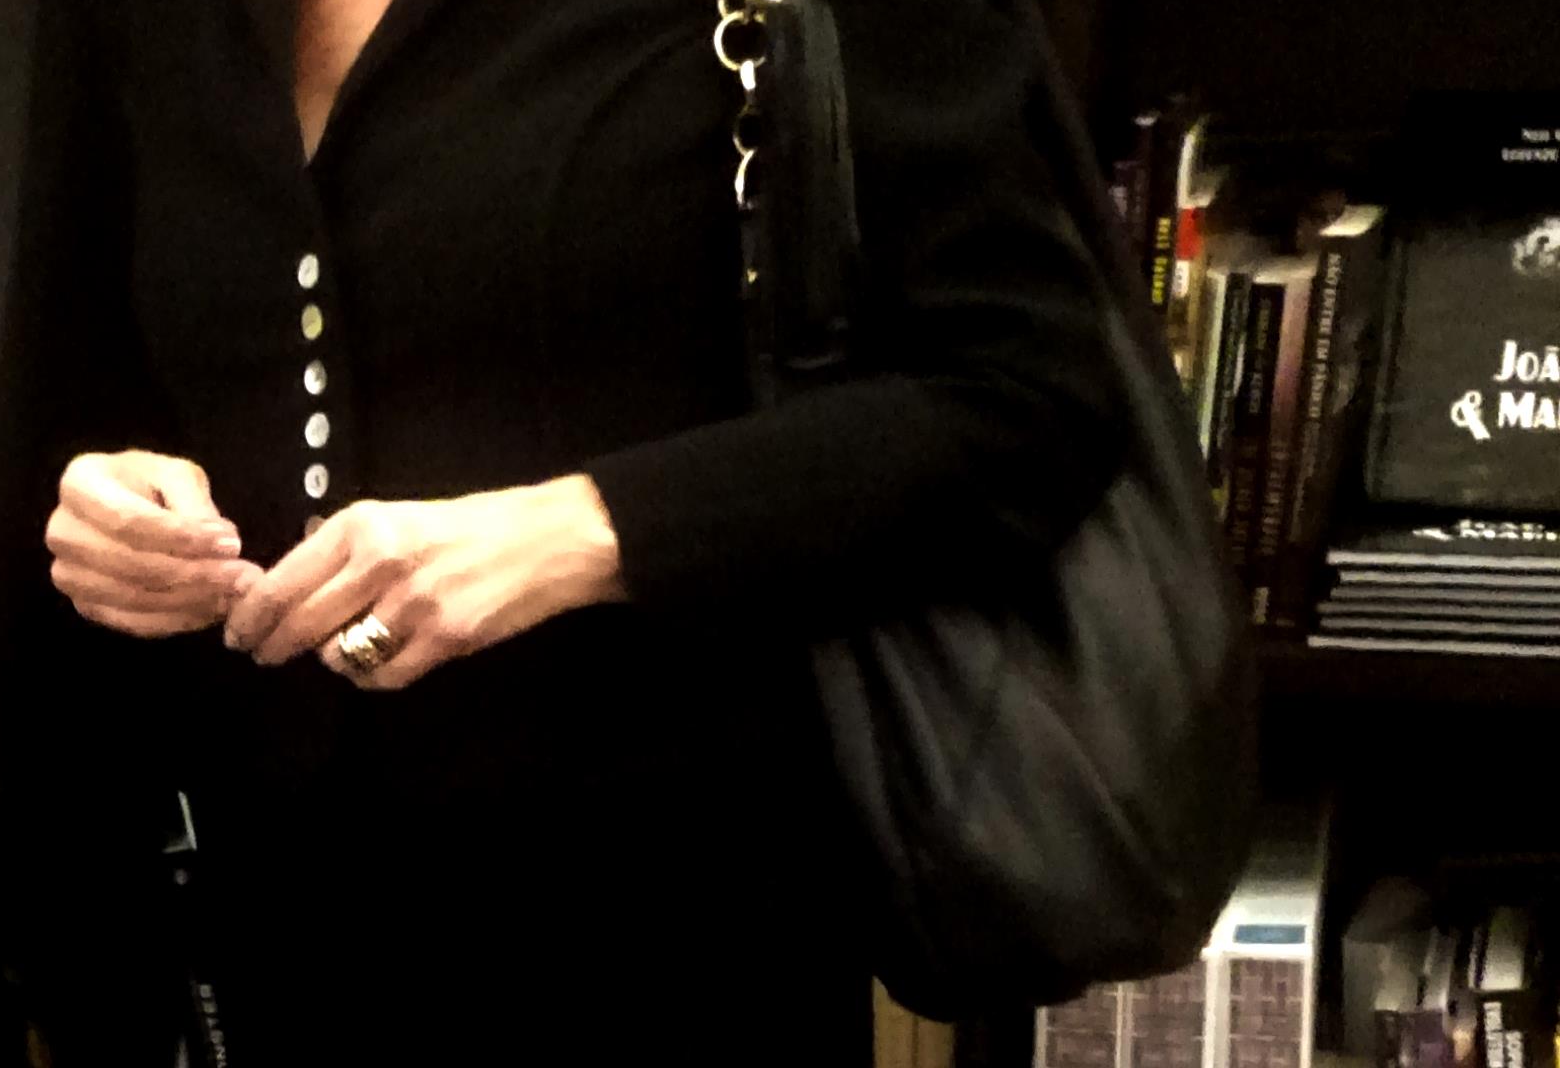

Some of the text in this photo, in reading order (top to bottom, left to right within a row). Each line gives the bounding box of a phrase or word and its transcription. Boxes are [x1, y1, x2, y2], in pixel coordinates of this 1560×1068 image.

[1314, 337, 1331, 360] EM
[1493, 339, 1560, 383] JOÃ
[1450, 389, 1492, 441] &
